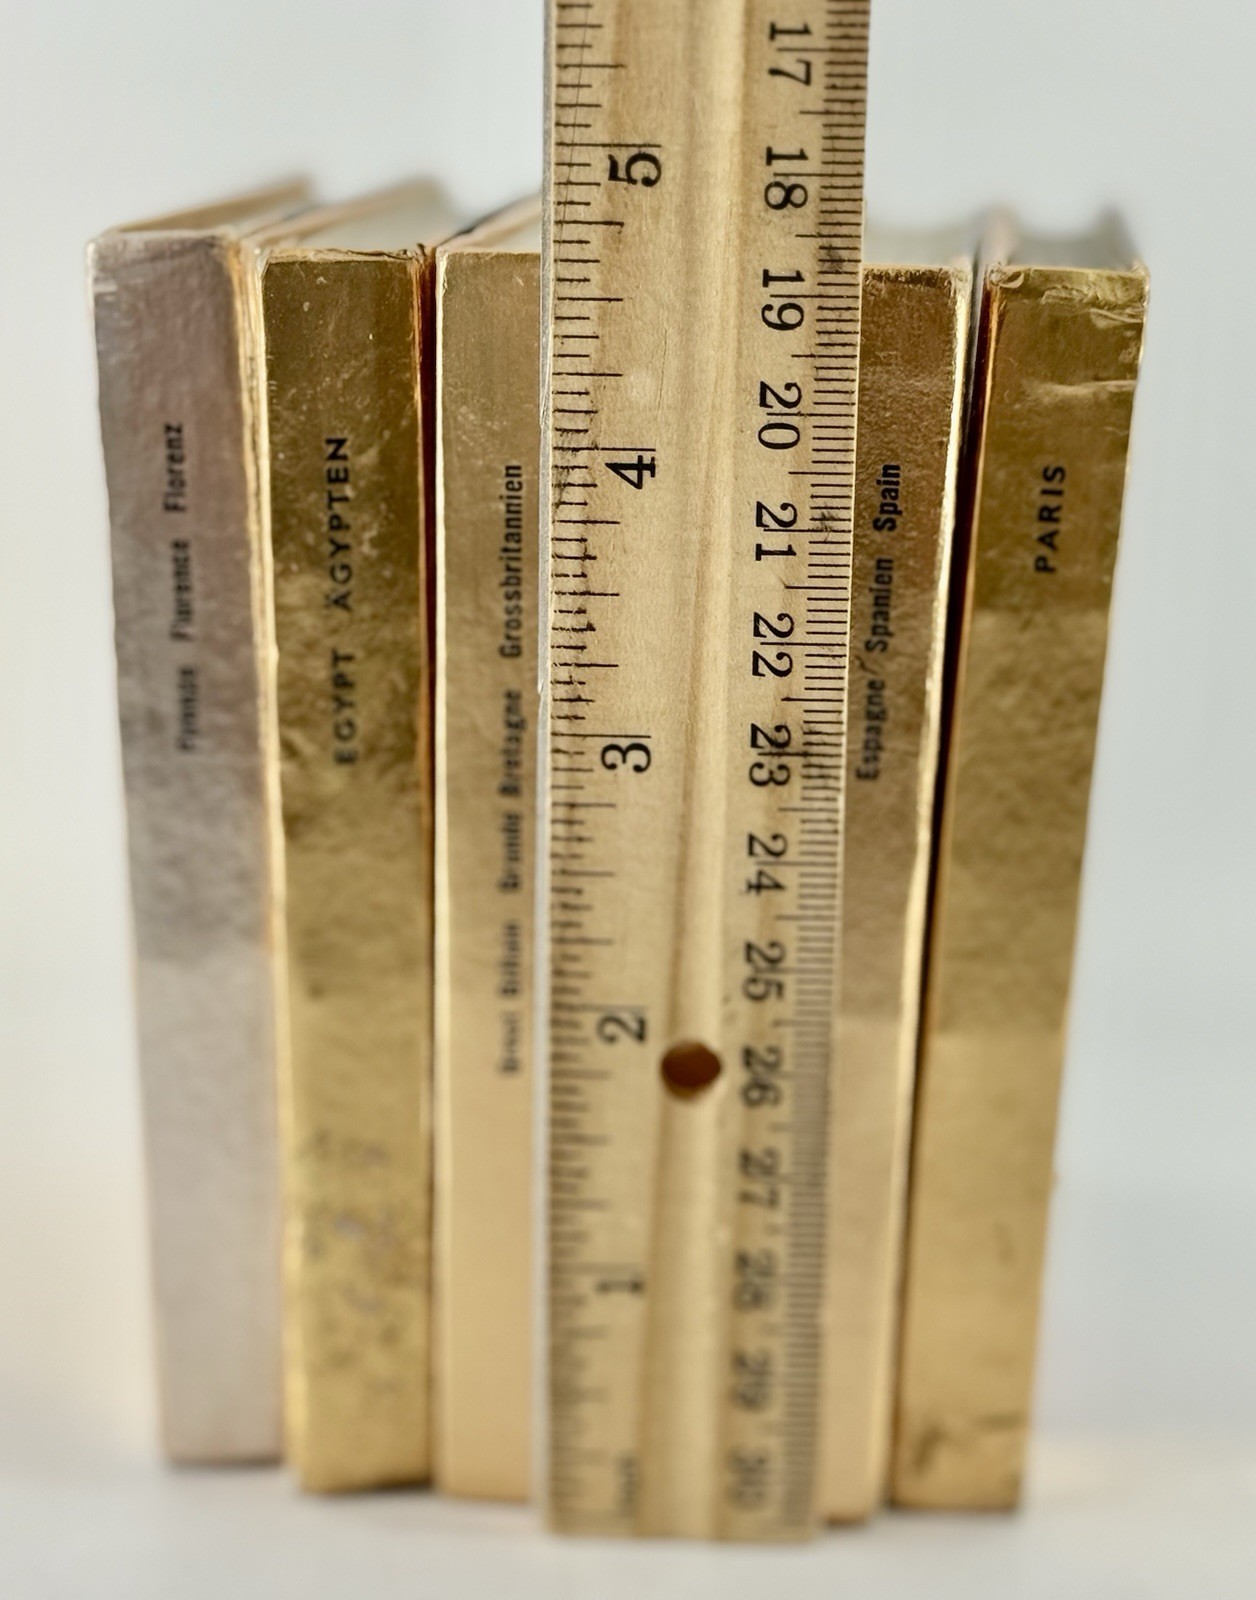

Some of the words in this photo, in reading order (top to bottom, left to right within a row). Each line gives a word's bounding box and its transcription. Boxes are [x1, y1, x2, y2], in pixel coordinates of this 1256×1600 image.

[768, 22, 812, 86] 17
[608, 151, 662, 187] 5
[764, 146, 809, 210] 18
[761, 269, 805, 331] 19
[758, 381, 802, 450] 20
[163, 422, 187, 513] Florenz
[605, 455, 656, 490] 4
[873, 464, 902, 532] Spain
[325, 437, 353, 613] ÄGYPTEN
[755, 501, 798, 561] 21
[1035, 465, 1066, 573] PARIS
[499, 465, 522, 658] Grossbritannien
[865, 558, 894, 653] Spanien
[752, 612, 795, 677] 22
[332, 649, 357, 765] EGYPT
[856, 679, 888, 781] Espagne
[601, 742, 651, 773] 3
[749, 723, 791, 787] 23
[746, 832, 787, 896] 24
[743, 941, 786, 1002] 25
[597, 1014, 648, 1045] 2
[740, 1046, 783, 1108] 26
[595, 1277, 644, 1297] 1
